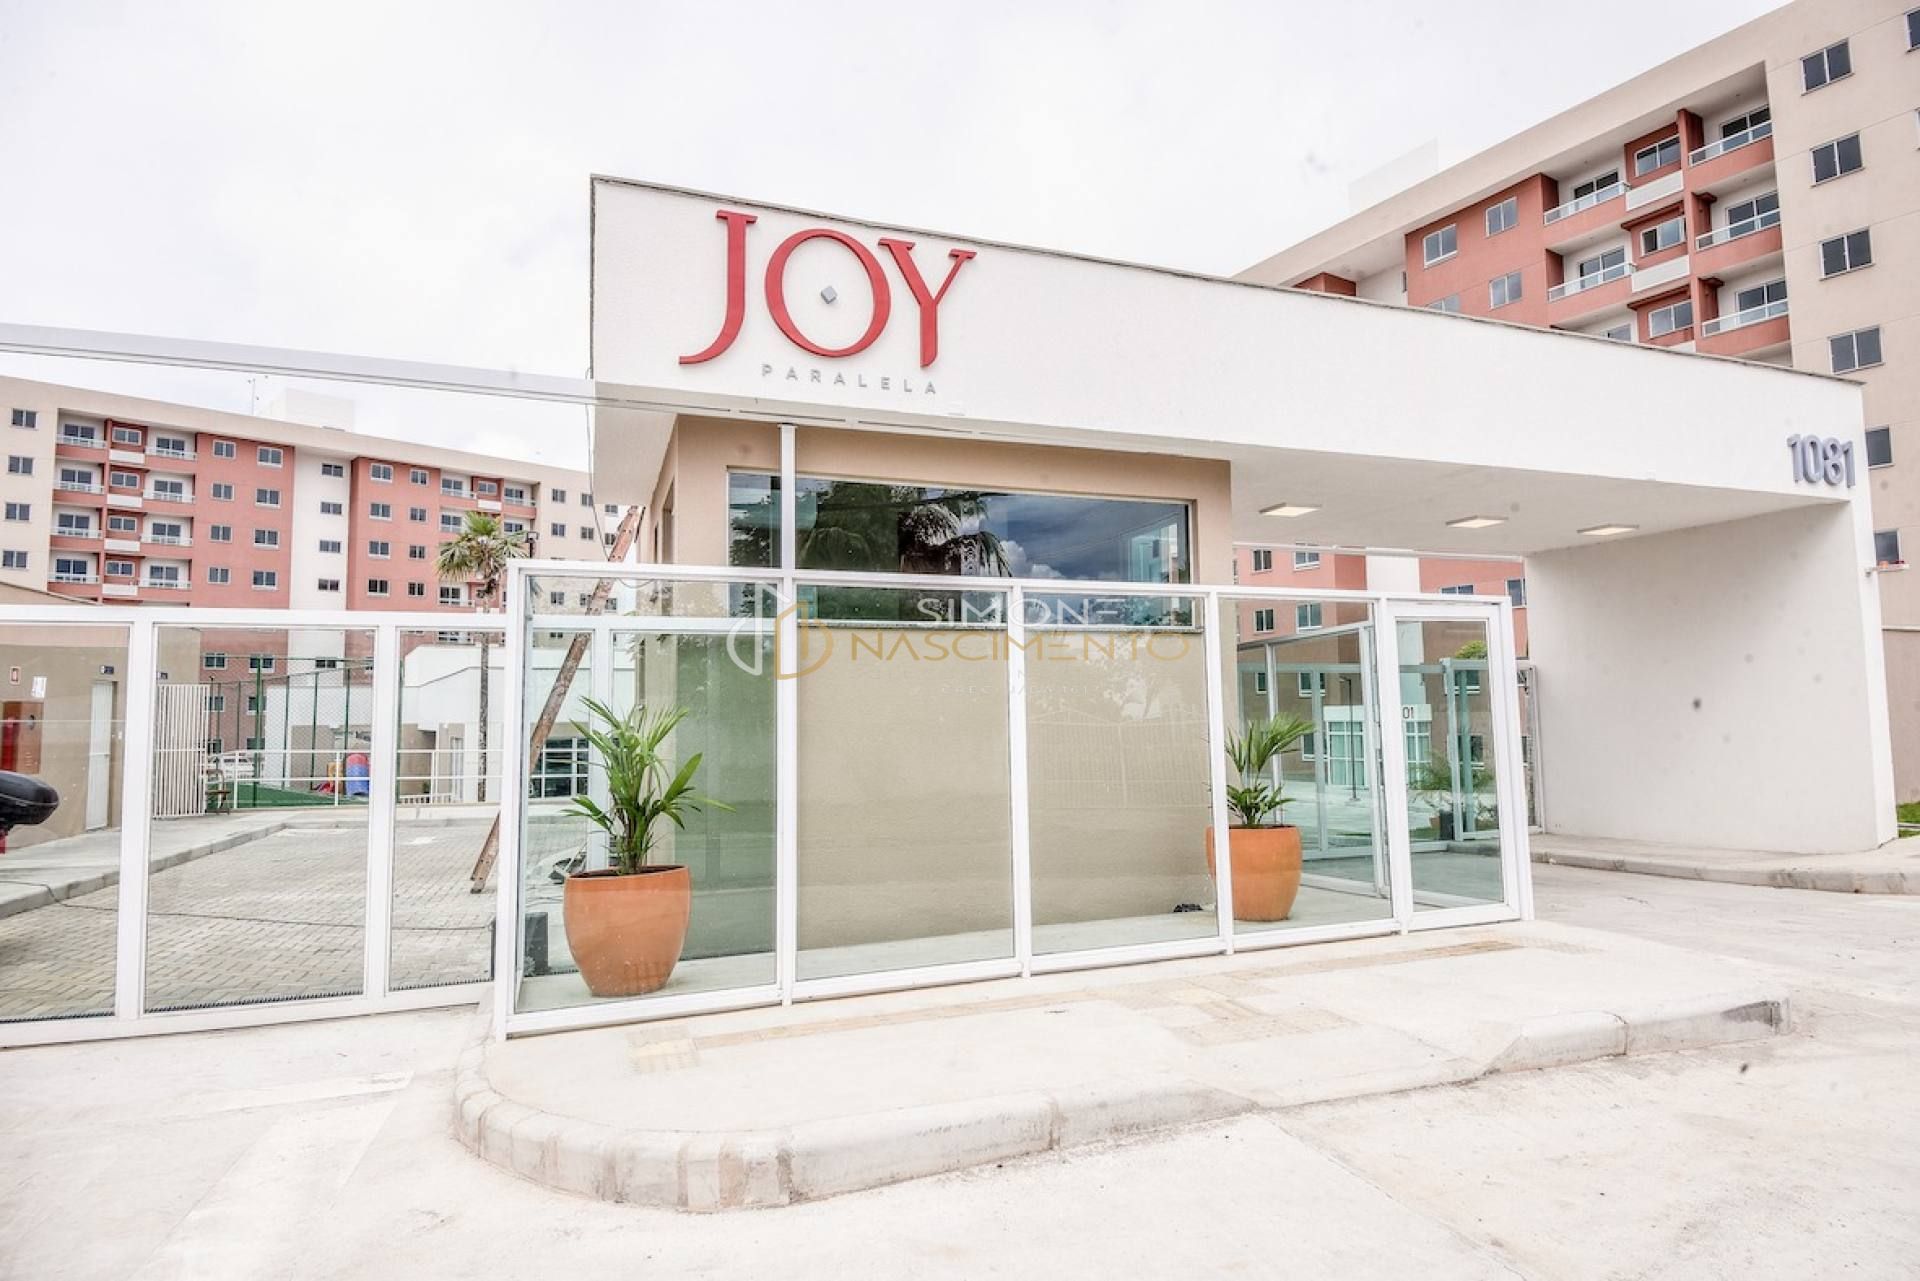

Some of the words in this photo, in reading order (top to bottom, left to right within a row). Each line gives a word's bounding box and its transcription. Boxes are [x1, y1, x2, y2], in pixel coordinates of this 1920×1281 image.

[678, 209, 977, 369] JOY
[761, 363, 937, 395] PARALELA
[1786, 433, 1856, 488] 1081
